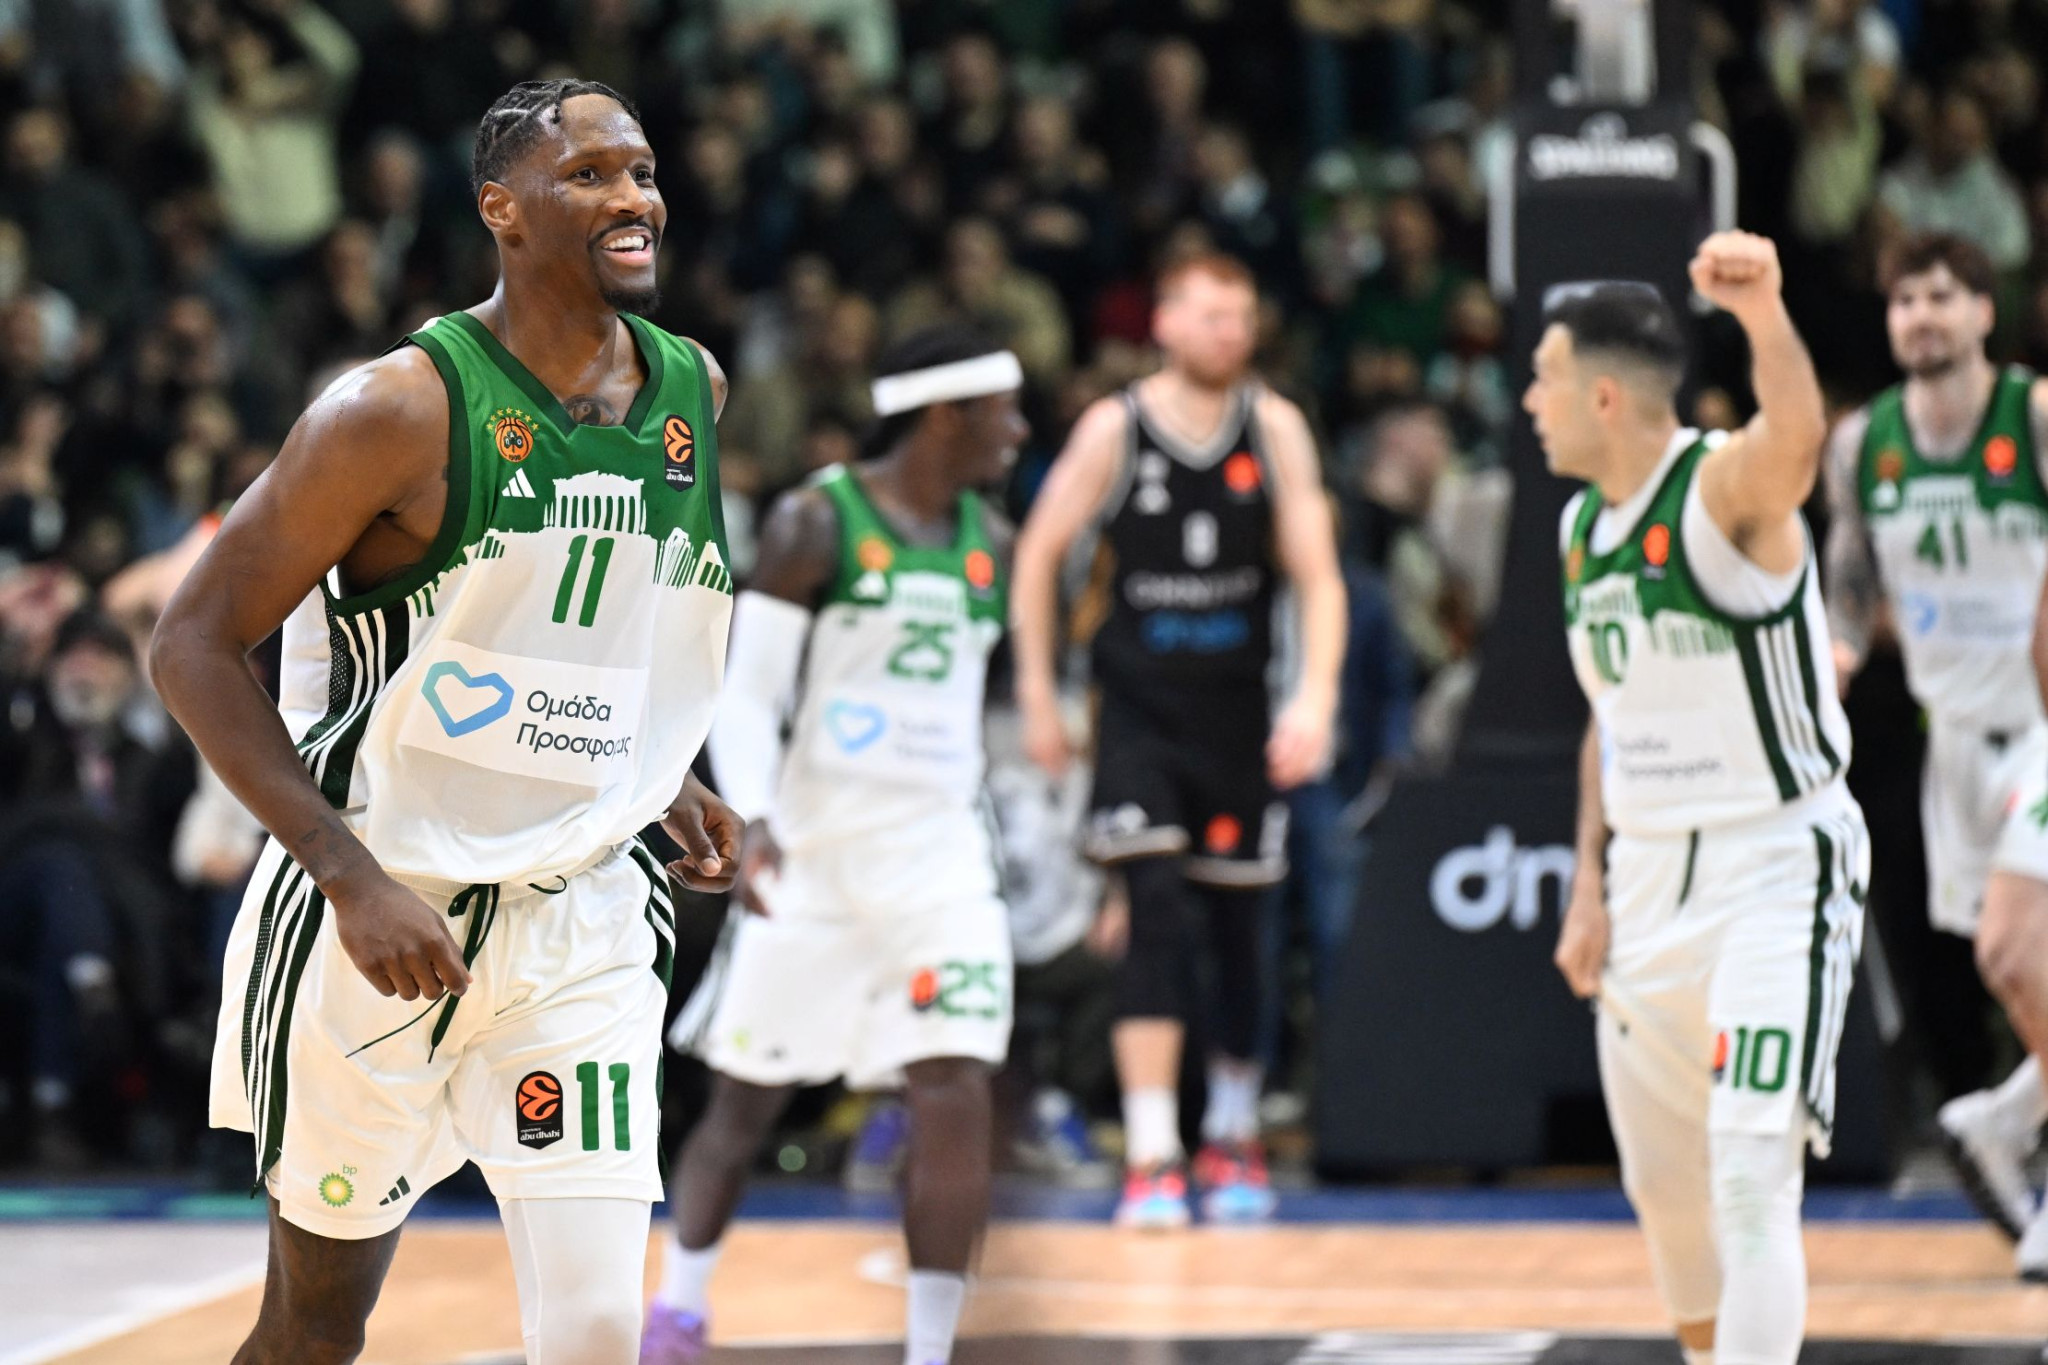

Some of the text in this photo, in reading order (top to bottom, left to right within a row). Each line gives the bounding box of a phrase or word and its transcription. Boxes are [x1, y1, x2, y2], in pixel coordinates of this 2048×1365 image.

[1915, 520, 1968, 571] 41
[552, 534, 615, 627] 11
[888, 620, 953, 682] 25
[1587, 621, 1629, 683] 10
[526, 690, 612, 722] Ομάδα
[939, 960, 999, 1018] 25
[1733, 1027, 1791, 1093] 10
[520, 1129, 560, 1141] abu dhabi
[576, 1061, 631, 1151] 11
[342, 1163, 358, 1176] bp
